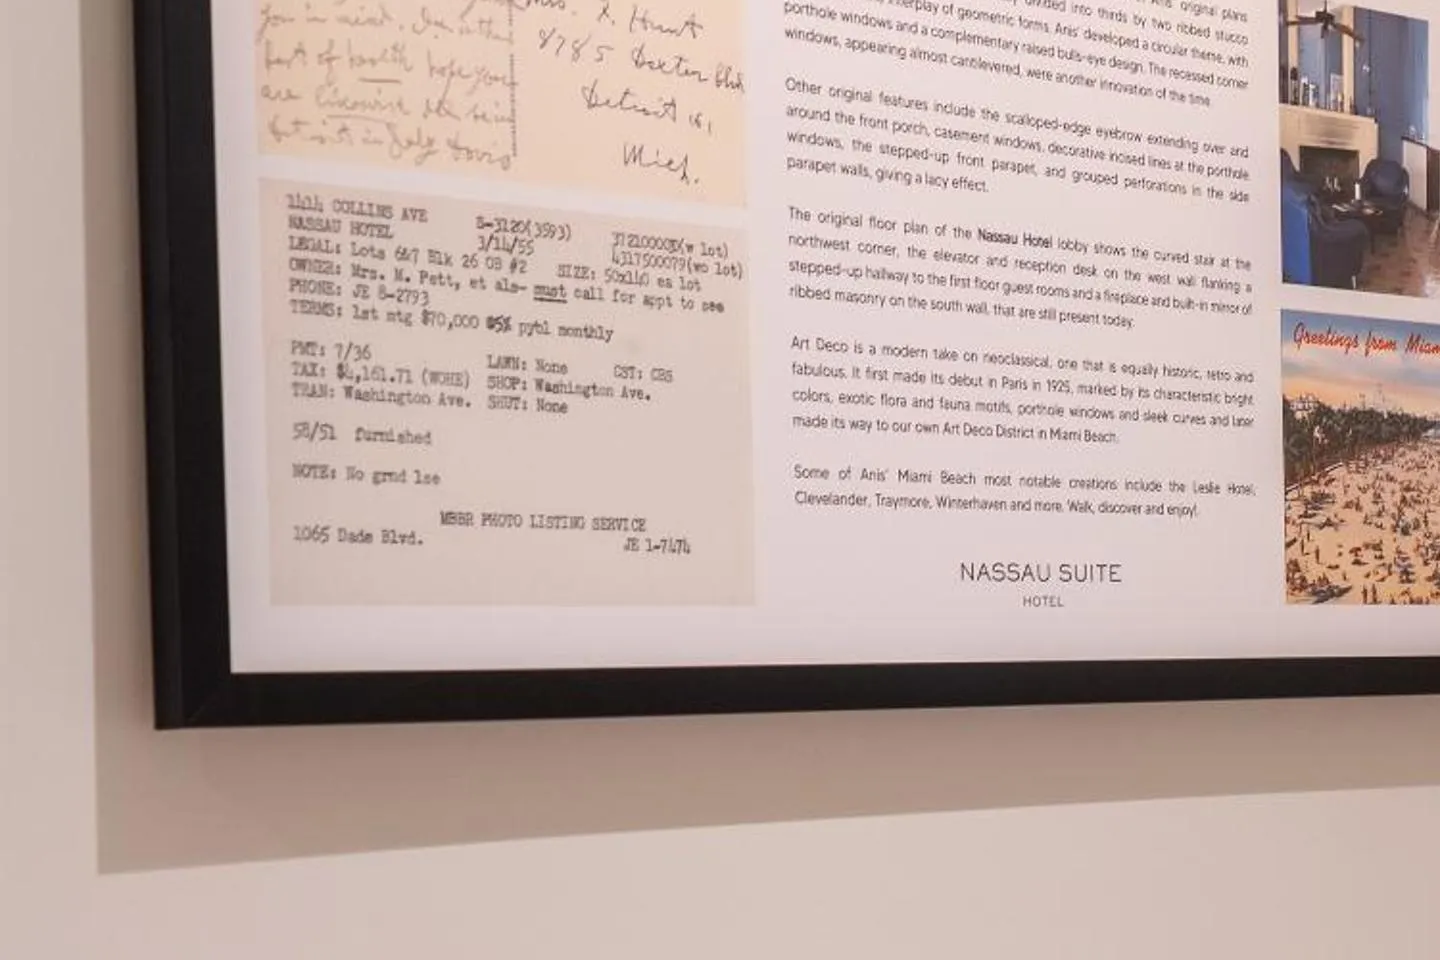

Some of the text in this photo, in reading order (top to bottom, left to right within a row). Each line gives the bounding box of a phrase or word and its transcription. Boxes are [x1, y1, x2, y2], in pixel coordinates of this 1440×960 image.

[785, 156, 988, 194] parapet walls, giving a lacy effect.
[401, 207, 428, 223] AVE
[288, 216, 394, 240] NASSAU HOTEL
[788, 205, 1089, 258] The original floor plan of the Nassau Hotel lobby
[788, 282, 1135, 332] ribbed masonry on the south wall, that are still present today.
[1293, 321, 1360, 355] Greetings
[1364, 331, 1397, 357] from
[343, 385, 431, 406] Washington
[534, 378, 615, 399] Washington
[791, 412, 828, 429] made
[830, 413, 845, 430] its
[848, 418, 873, 435] way
[875, 416, 889, 432] to
[892, 420, 912, 433] our
[914, 422, 939, 435] own
[942, 419, 960, 436] Art
[962, 421, 993, 437] Deco
[995, 422, 1034, 440] District
[1037, 425, 1047, 440] in
[1049, 425, 1081, 442] Miami
[793, 489, 872, 509] Clevelander,
[874, 491, 932, 512] Traymore,
[934, 494, 1007, 511] Winterhaven
[1009, 497, 1031, 512] and
[1066, 498, 1095, 516] Walk,
[1097, 499, 1142, 515] discover
[1144, 501, 1164, 516] and
[592, 516, 648, 534] SERVICE
[960, 562, 1122, 583] NASSAU SUITE
[1023, 595, 1065, 608] HOTEL
